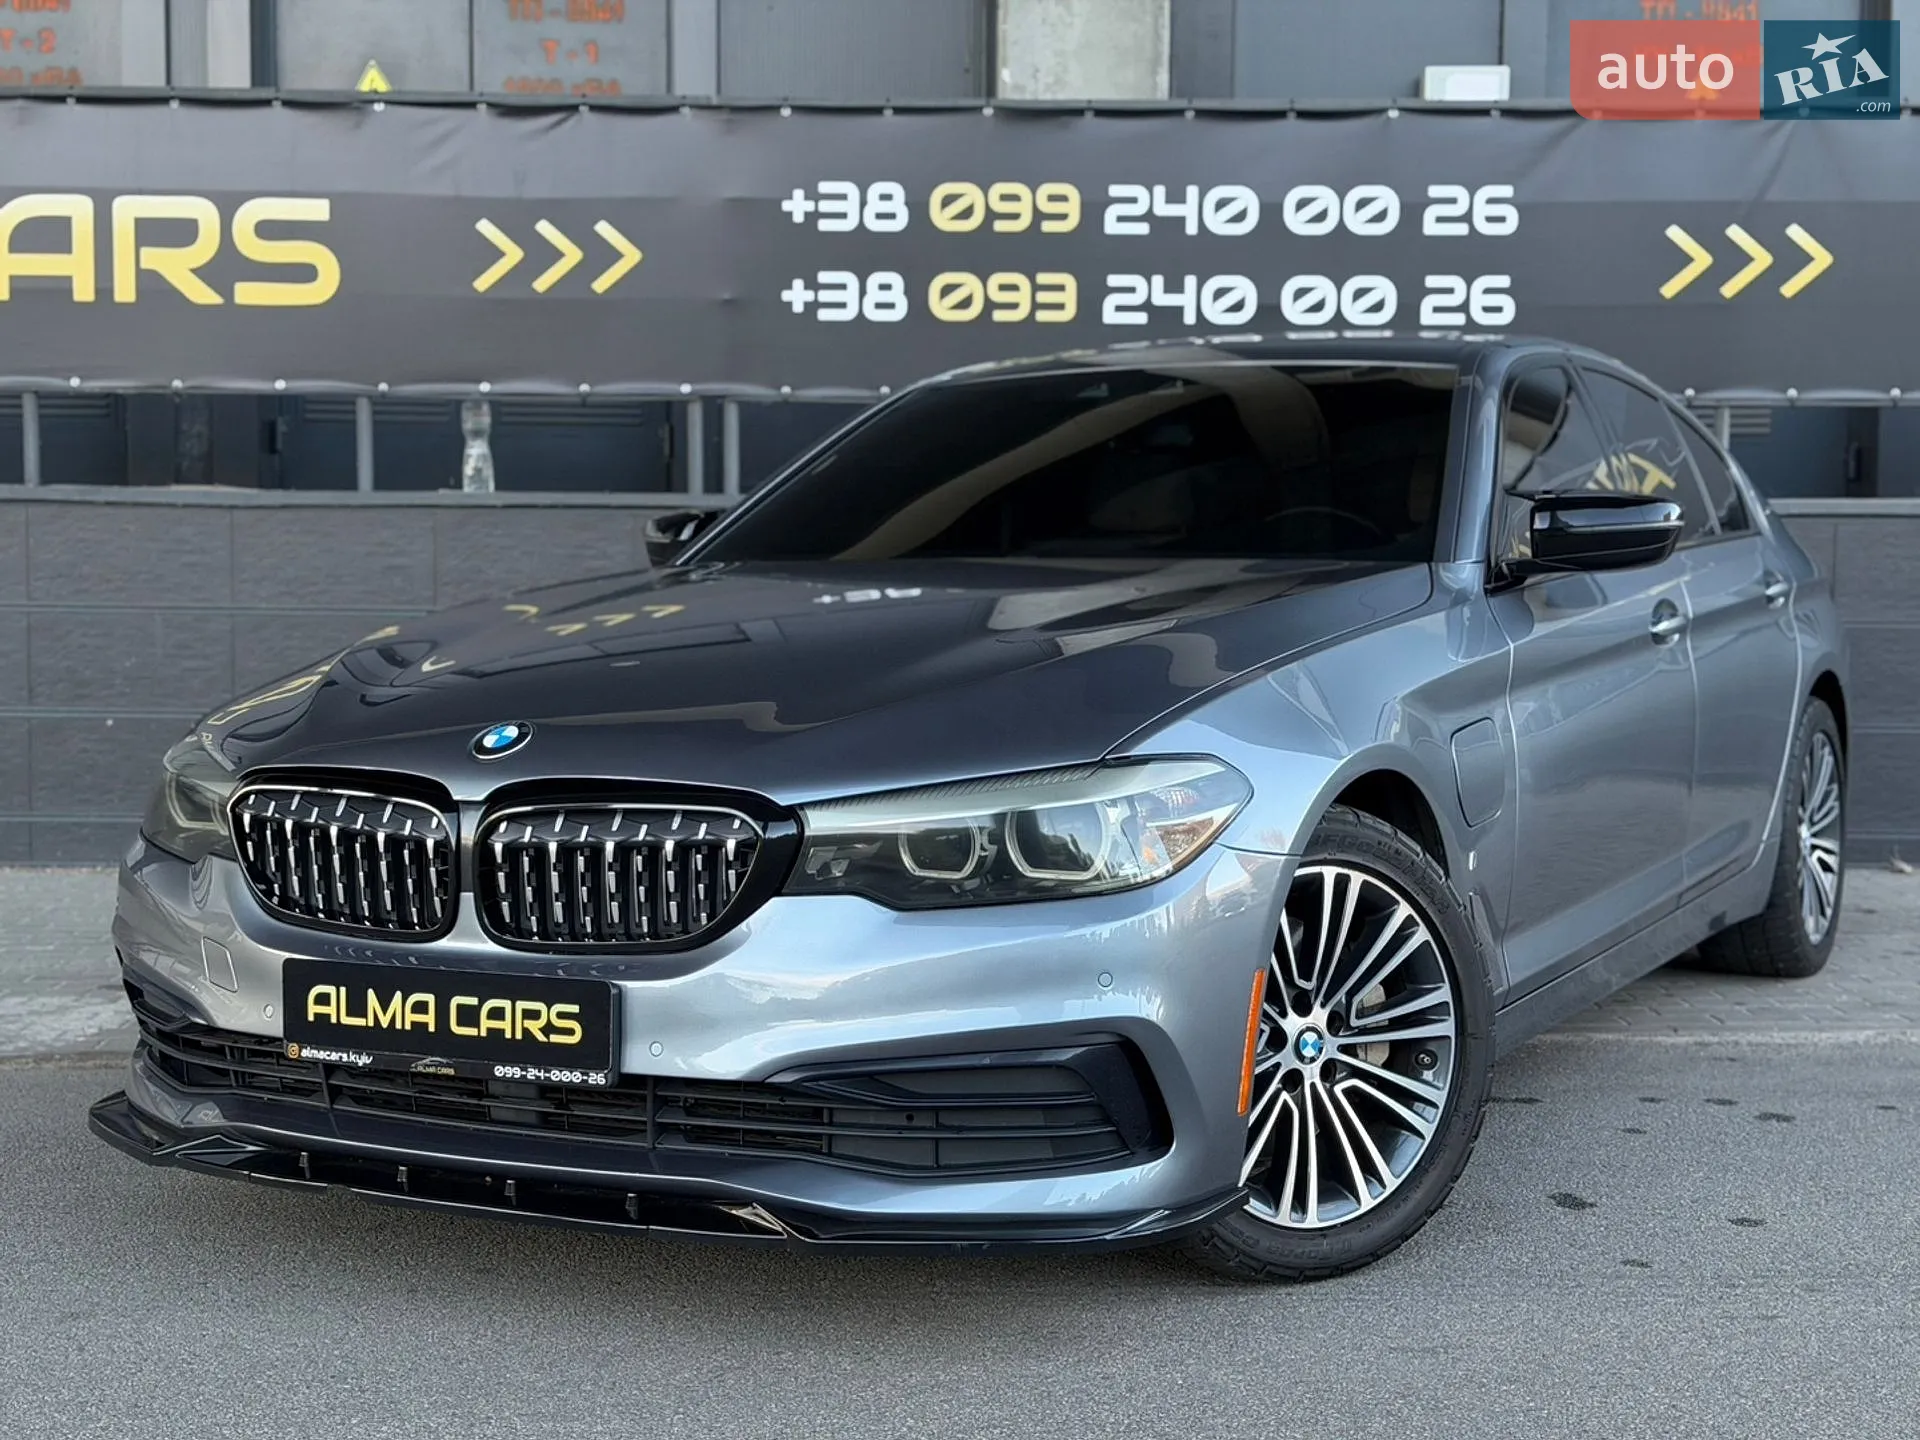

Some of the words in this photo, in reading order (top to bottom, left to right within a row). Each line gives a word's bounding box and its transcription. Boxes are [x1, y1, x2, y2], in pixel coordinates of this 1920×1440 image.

[781, 181, 909, 232] +38
[929, 181, 1081, 233] 099
[1103, 184, 1260, 236] 240
[1282, 184, 1401, 236] 00
[1422, 184, 1520, 236] 26
[780, 270, 909, 322] +38
[928, 271, 1077, 322] 093
[1102, 274, 1258, 326] 240
[1280, 274, 1398, 326] 00
[1419, 274, 1516, 326] 26
[307, 984, 436, 1033] ALMA
[449, 995, 583, 1045] CARS
[493, 1065, 607, 1086] 099-24-000-26
